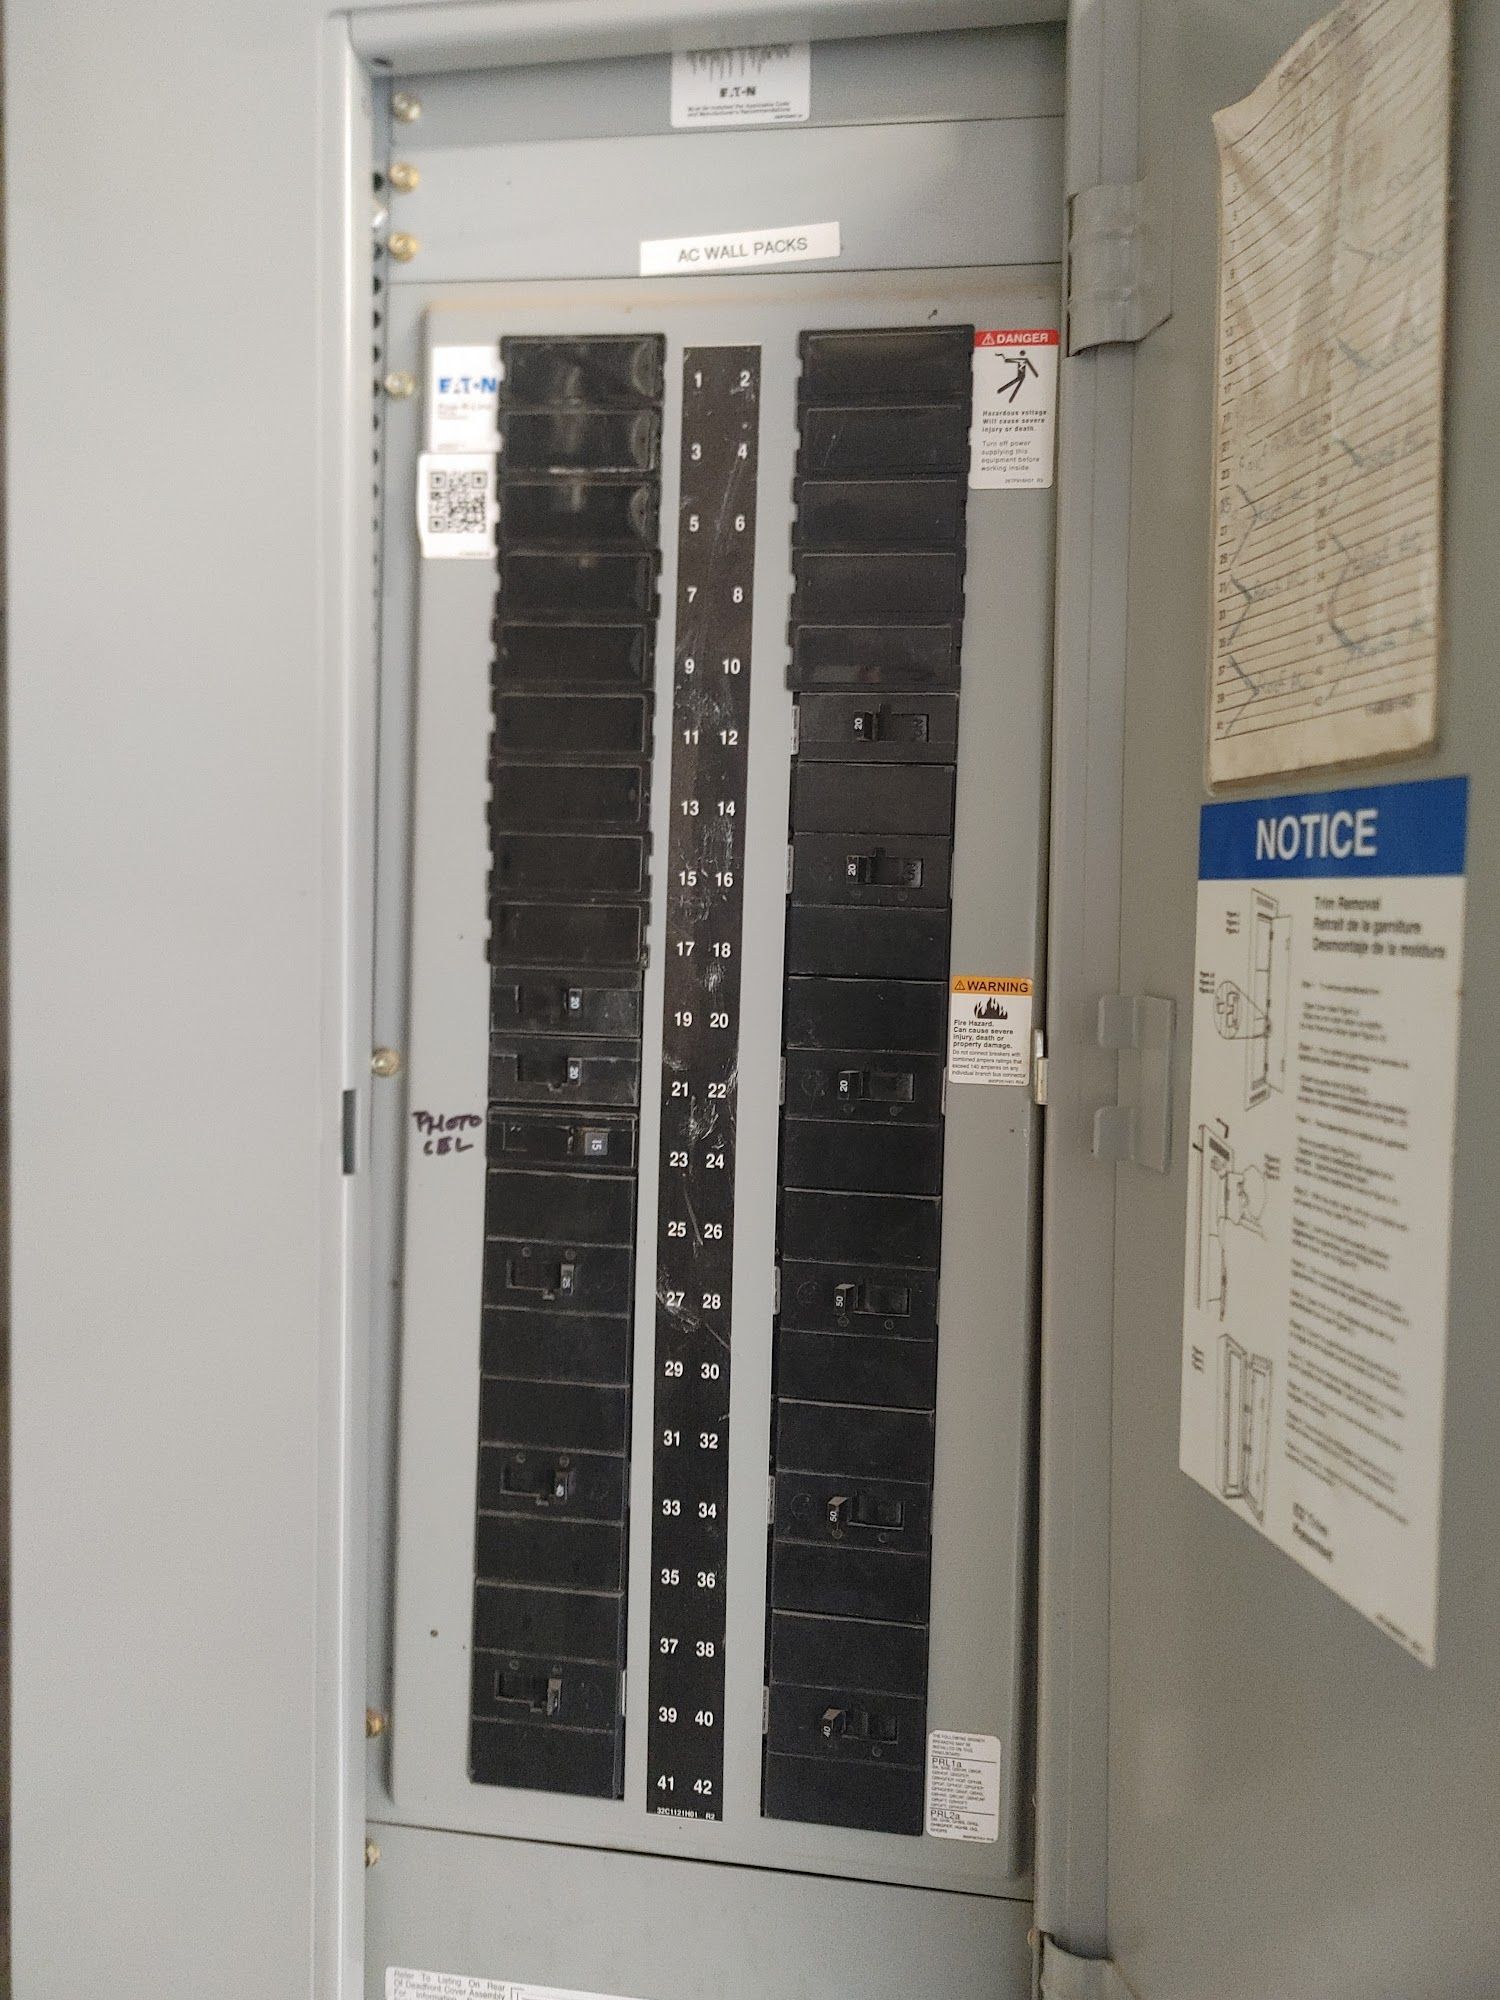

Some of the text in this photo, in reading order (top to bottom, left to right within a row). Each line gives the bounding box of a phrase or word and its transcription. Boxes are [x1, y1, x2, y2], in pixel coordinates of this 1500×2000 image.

[678, 237, 809, 263] AC WALL PACKS
[996, 332, 1050, 344] DANGER
[692, 370, 752, 390] 1 2
[690, 443, 749, 462] 3 4
[1010, 440, 1031, 448] power
[688, 515, 747, 533] 5 6
[686, 586, 744, 605] 7 8
[683, 658, 742, 676] 9 10
[682, 729, 739, 747] 11 12
[679, 800, 737, 818] 13 14
[1256, 808, 1378, 861] NOTICE
[848, 863, 857, 876] 20
[677, 870, 735, 889] 15 16
[675, 941, 732, 959] 17 18
[967, 981, 1029, 994] WARNING
[673, 1011, 730, 1030] 19 20
[954, 1026, 967, 1034] Can
[952, 1041, 1013, 1050] property damage.
[670, 1081, 728, 1100] 21 22
[840, 1080, 848, 1092] 20
[668, 1151, 726, 1170] 23 24
[666, 1221, 724, 1241] 25 26
[665, 1291, 723, 1311] 27 28
[835, 1295, 844, 1308] 50
[663, 1360, 721, 1381] 29 30
[662, 1430, 719, 1450] 31 32
[661, 1499, 718, 1520] 33 34
[829, 1510, 837, 1522] 50
[660, 1568, 717, 1590] 35 36
[658, 1637, 716, 1659] 37 38
[657, 1706, 715, 1728] 39 40
[656, 1775, 714, 1796] 41 42
[930, 1809, 960, 1820] PRL2a
[394, 1970, 505, 1991] Refer To Listing On Rear
[394, 1979, 403, 1987] Of
[444, 1986, 466, 1994] Cover
[470, 1989, 506, 2000] Assembly
